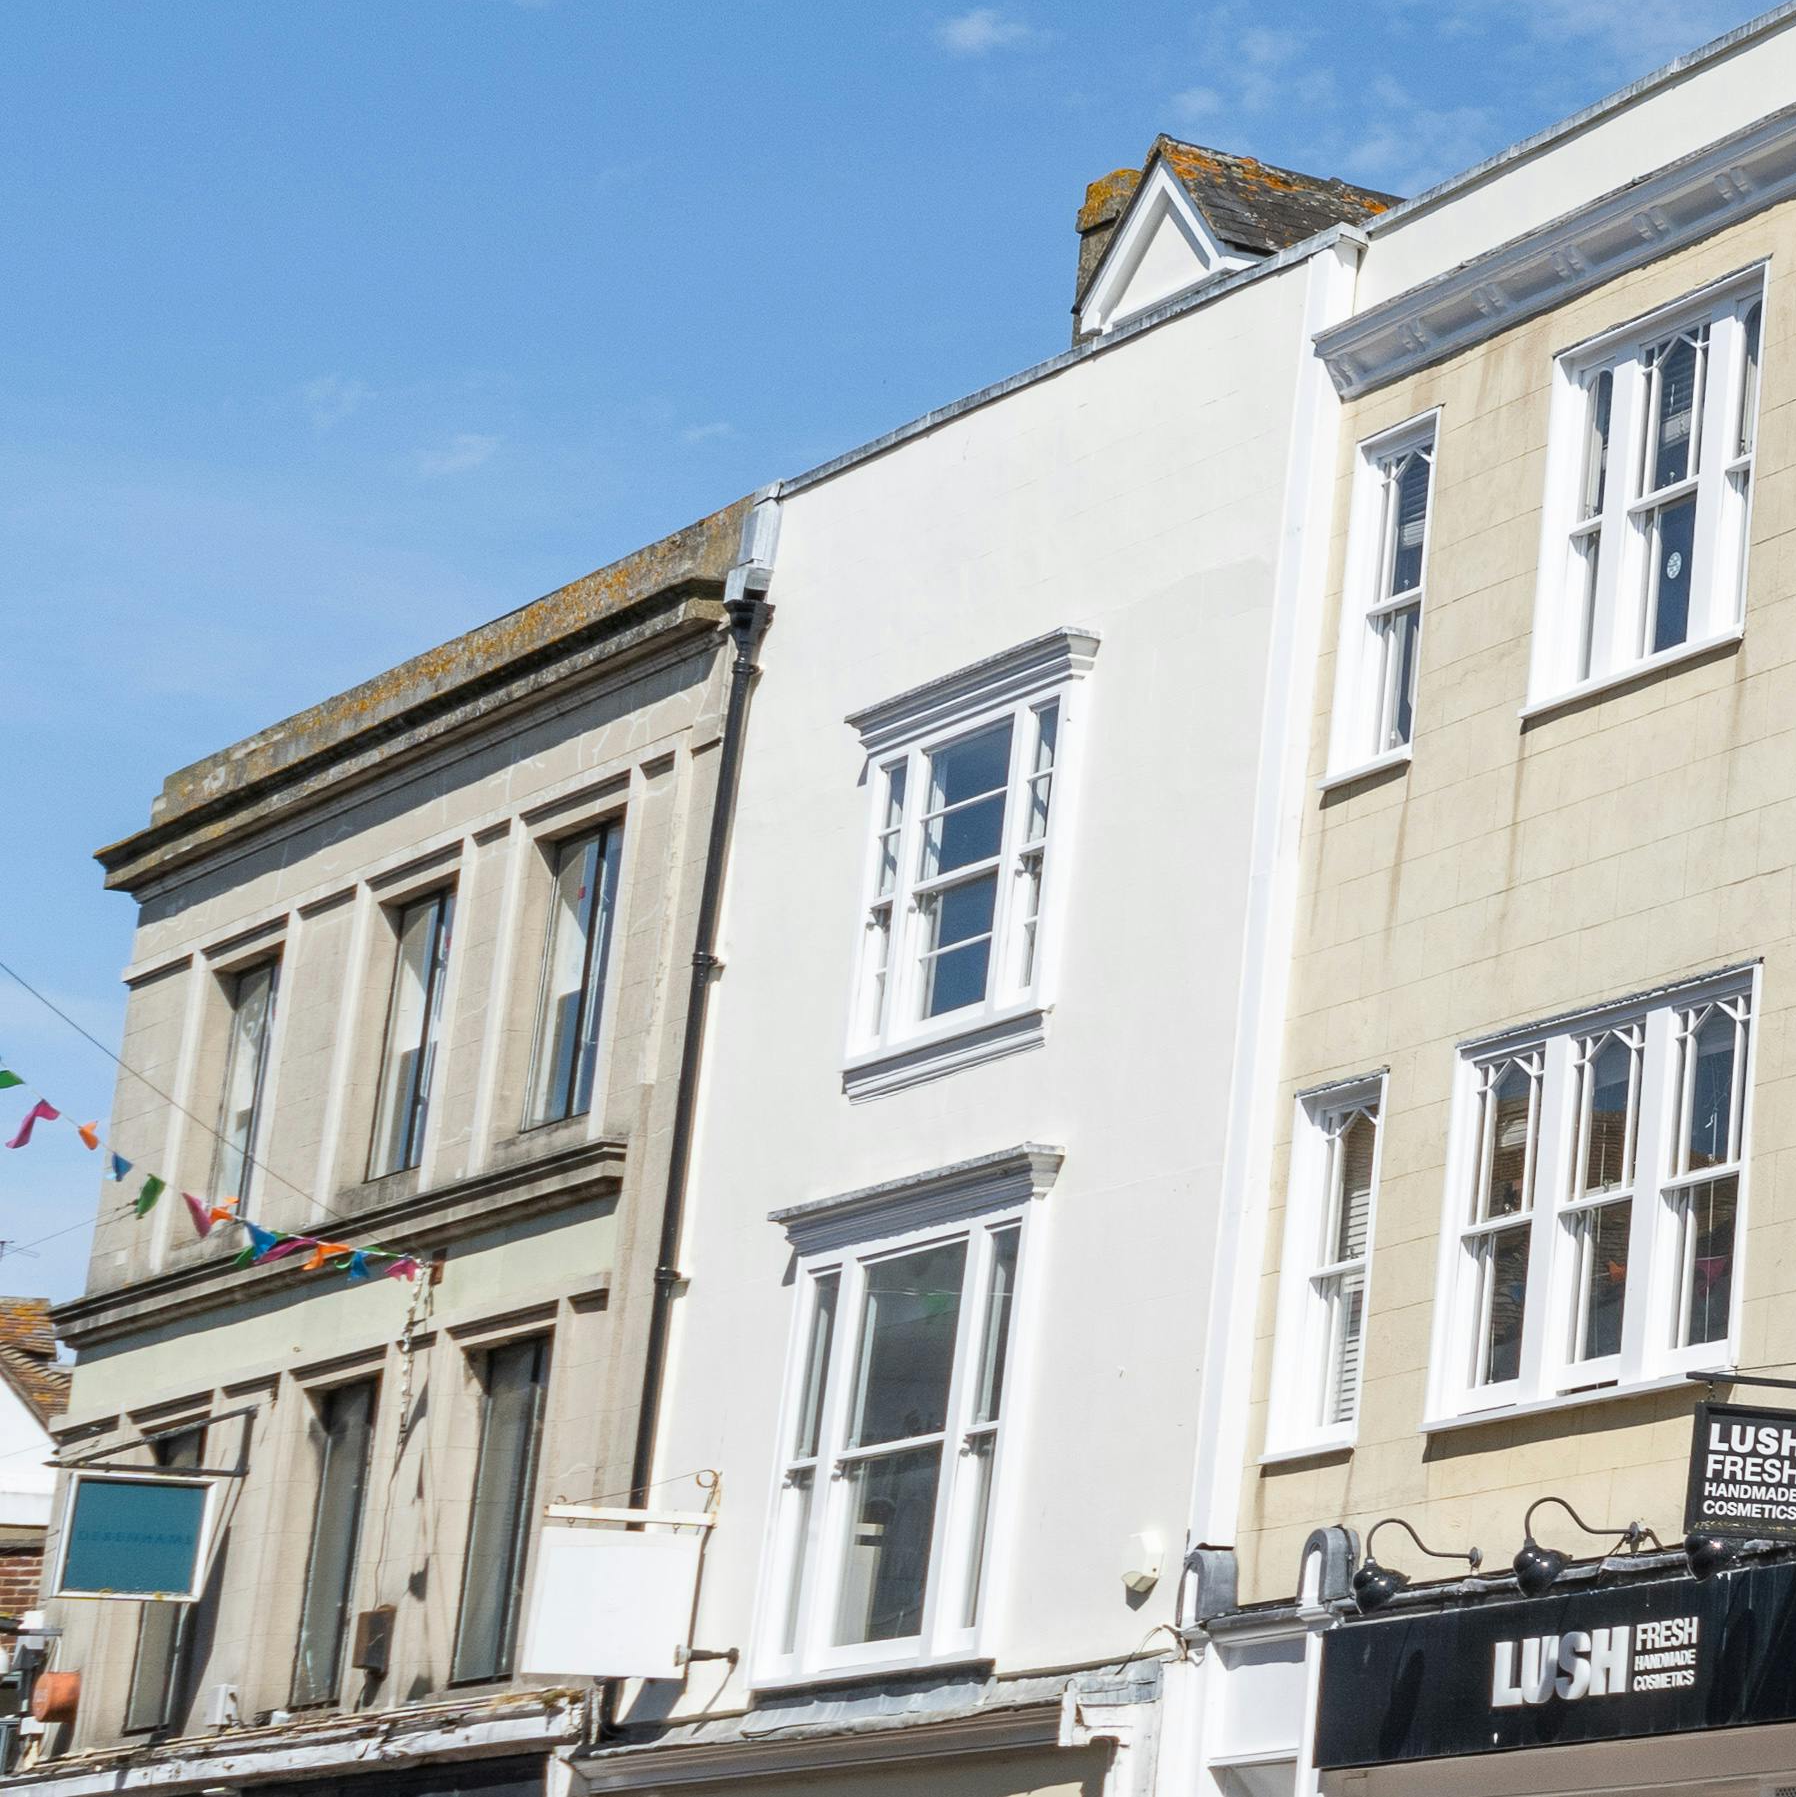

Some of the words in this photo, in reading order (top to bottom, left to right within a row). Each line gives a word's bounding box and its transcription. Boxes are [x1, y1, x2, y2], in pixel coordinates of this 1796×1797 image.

[1634, 1616, 1699, 1652] FRESH
[1492, 1624, 1631, 1709] LUSH
[1634, 1647, 1697, 1672] HANDMADE
[1633, 1669, 1696, 1692] COSMETICS
